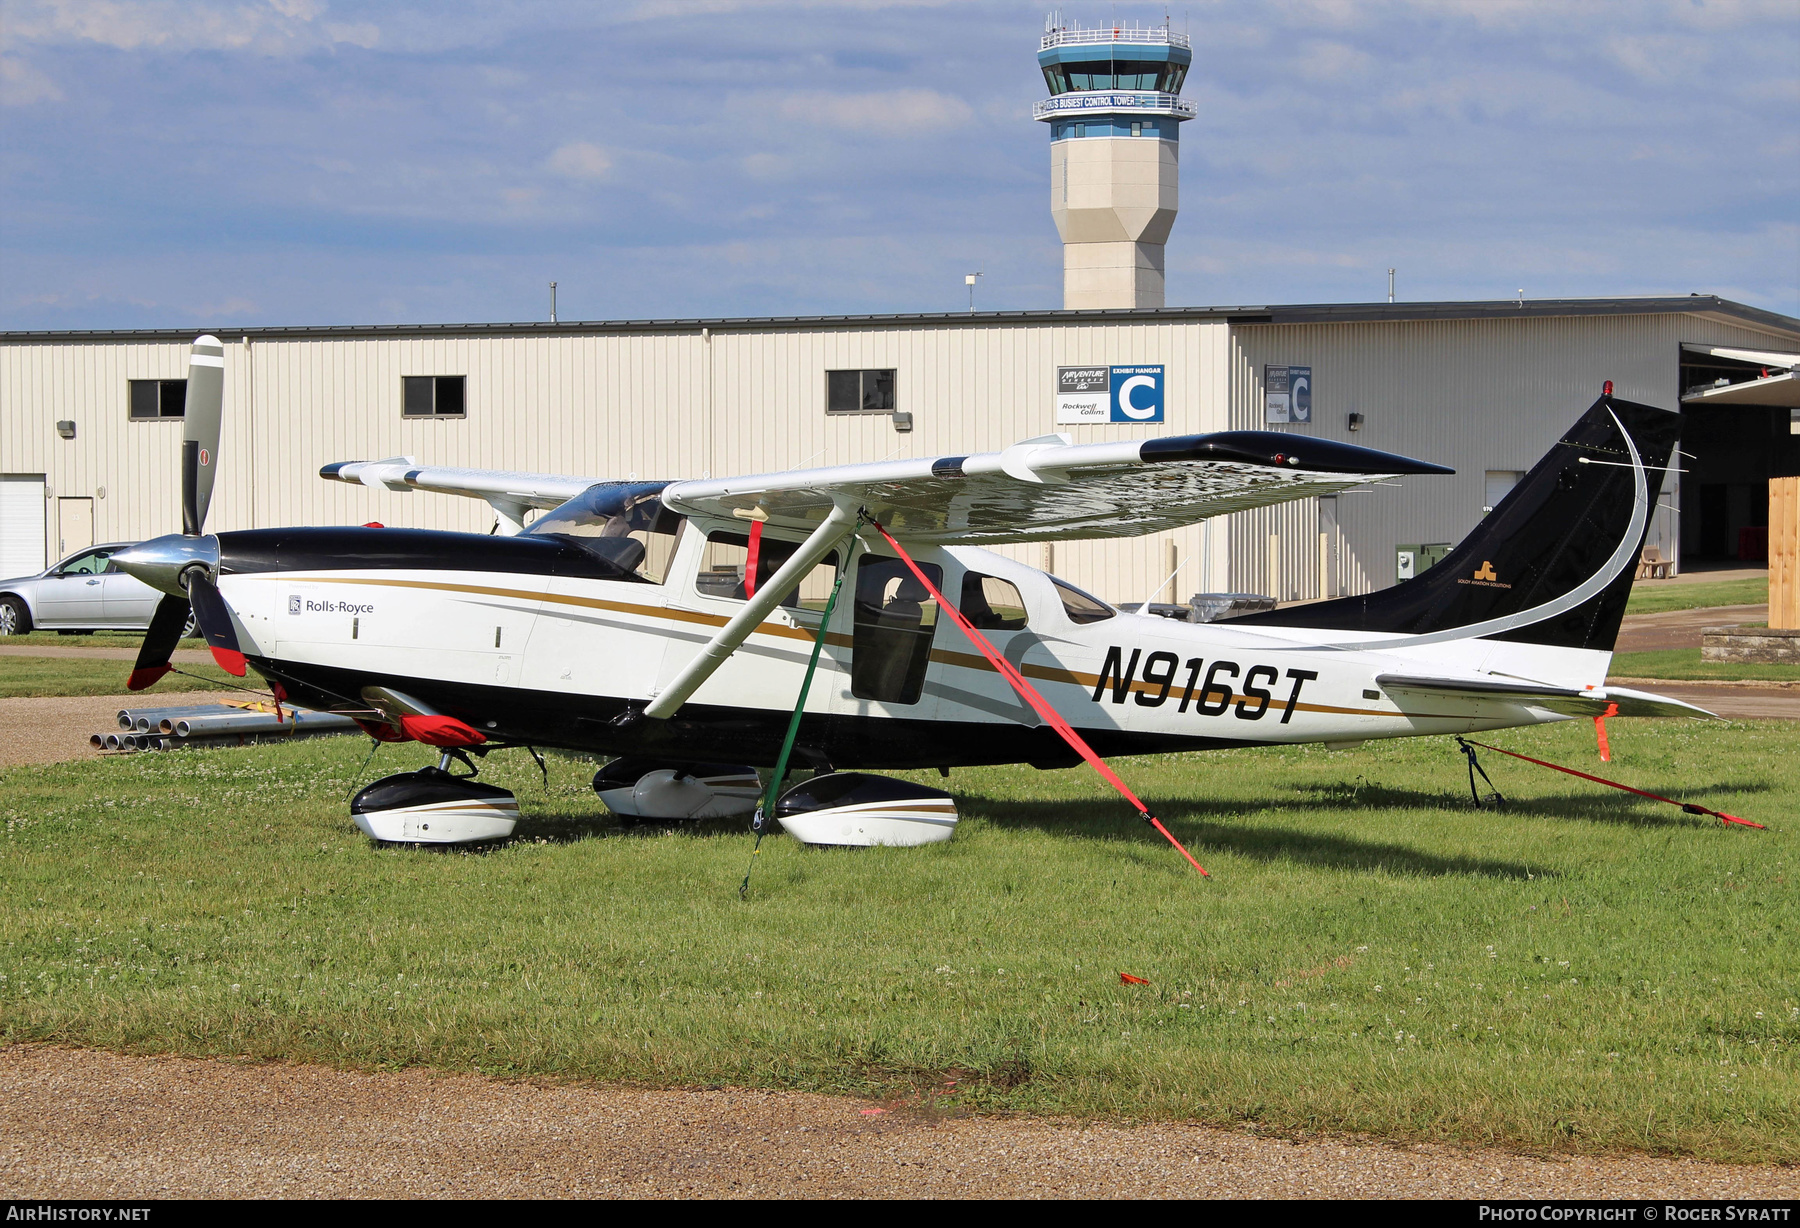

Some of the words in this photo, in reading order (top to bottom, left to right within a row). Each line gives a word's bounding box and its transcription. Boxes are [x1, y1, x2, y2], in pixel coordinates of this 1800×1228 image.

[1060, 98, 1084, 108] BUSIEST
[1084, 97, 1112, 107] CONTROL
[1113, 96, 1135, 106] TOWER
[1118, 375, 1155, 420] C
[1292, 377, 1308, 420] C
[306, 600, 374, 616] Rolls-Royce
[1091, 646, 1318, 724] N916ST
